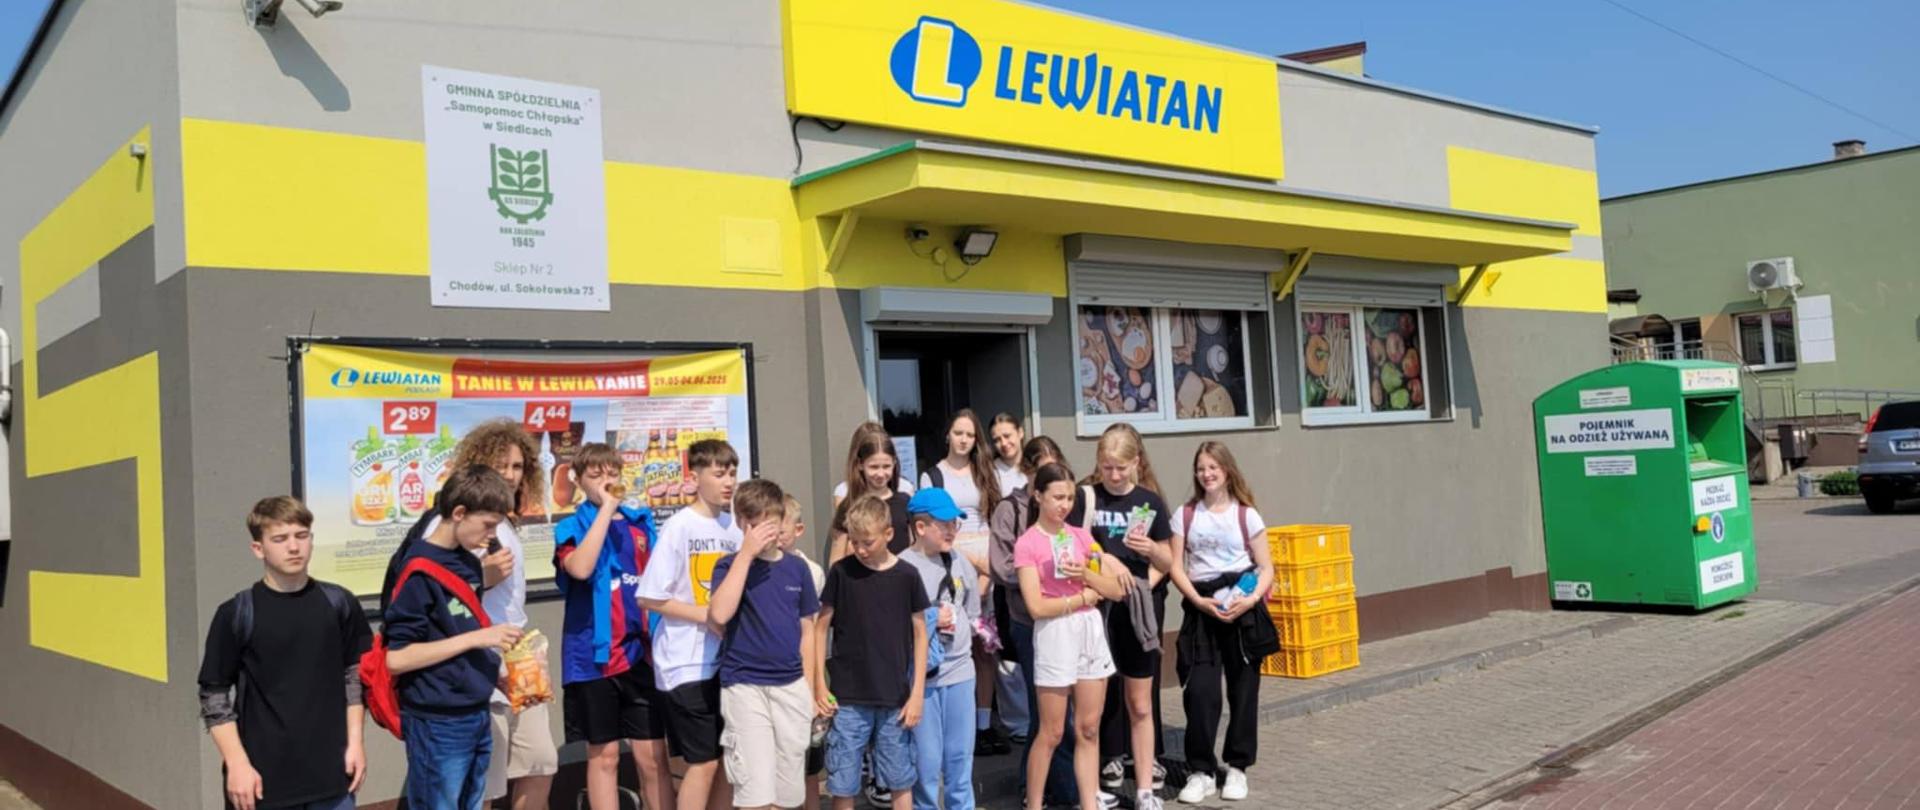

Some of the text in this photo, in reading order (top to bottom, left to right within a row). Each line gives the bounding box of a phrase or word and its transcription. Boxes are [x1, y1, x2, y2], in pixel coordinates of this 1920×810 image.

[446, 84, 581, 111] GMINNA SPÓŁDZIELNIA
[995, 46, 1222, 134] LEWIATAN
[483, 121, 552, 137] w Siedlcach
[511, 237, 535, 248] 1945
[494, 261, 553, 276] Sklep Nr 2
[449, 280, 594, 296] Chodów, ul. Sokołowska 73
[363, 371, 441, 385] LEWIATAN
[456, 375, 647, 391] TANIE W LEWIATANIE
[1579, 419, 1634, 431] POJEMNIK
[1551, 429, 1669, 444] NA ODZIEŻ UŻYWANĄ
[352, 449, 395, 474] TYMBARK
